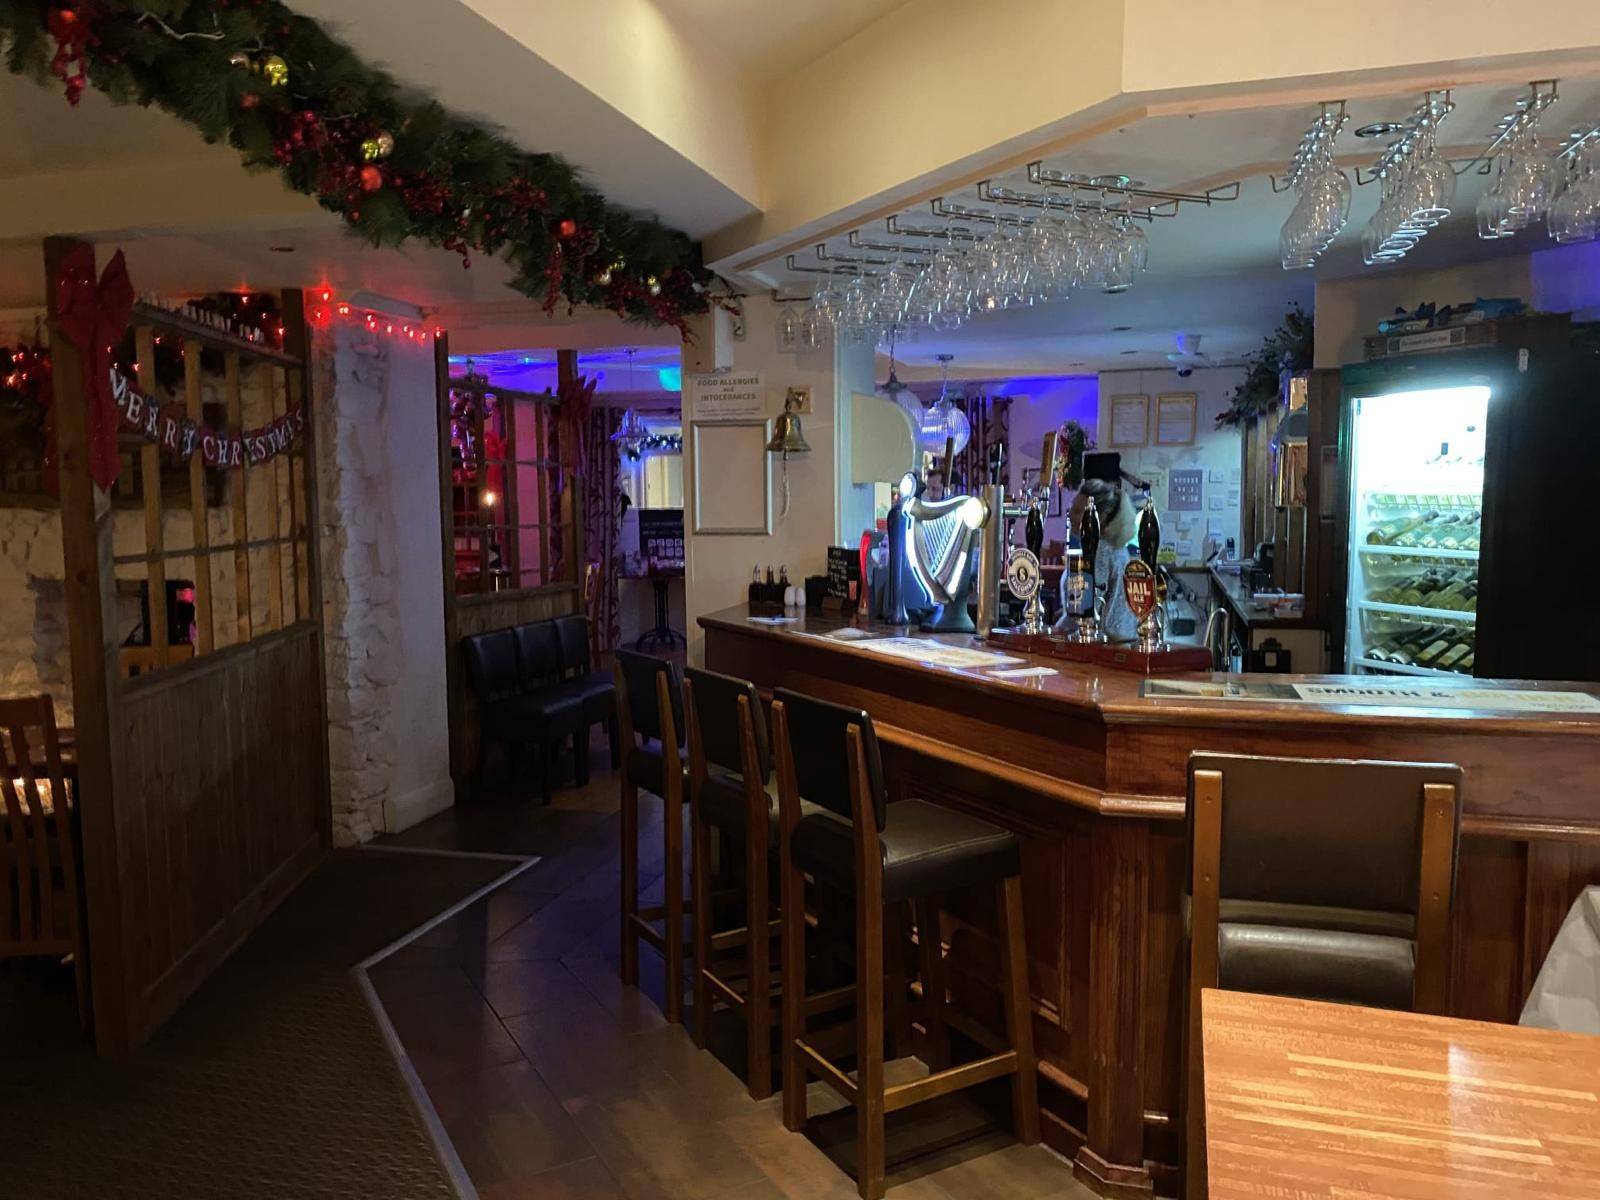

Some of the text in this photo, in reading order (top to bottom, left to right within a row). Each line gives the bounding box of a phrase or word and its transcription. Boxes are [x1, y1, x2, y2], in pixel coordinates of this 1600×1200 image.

[697, 377, 759, 387] FOOD ALLERGIES
[701, 392, 756, 401] INTOLERANCES
[109, 367, 304, 466] MERRY CHRISTMAS
[1127, 582, 1151, 596] JAIL
[1133, 595, 1145, 604] ALE
[1306, 686, 1421, 698] SMOOTH
